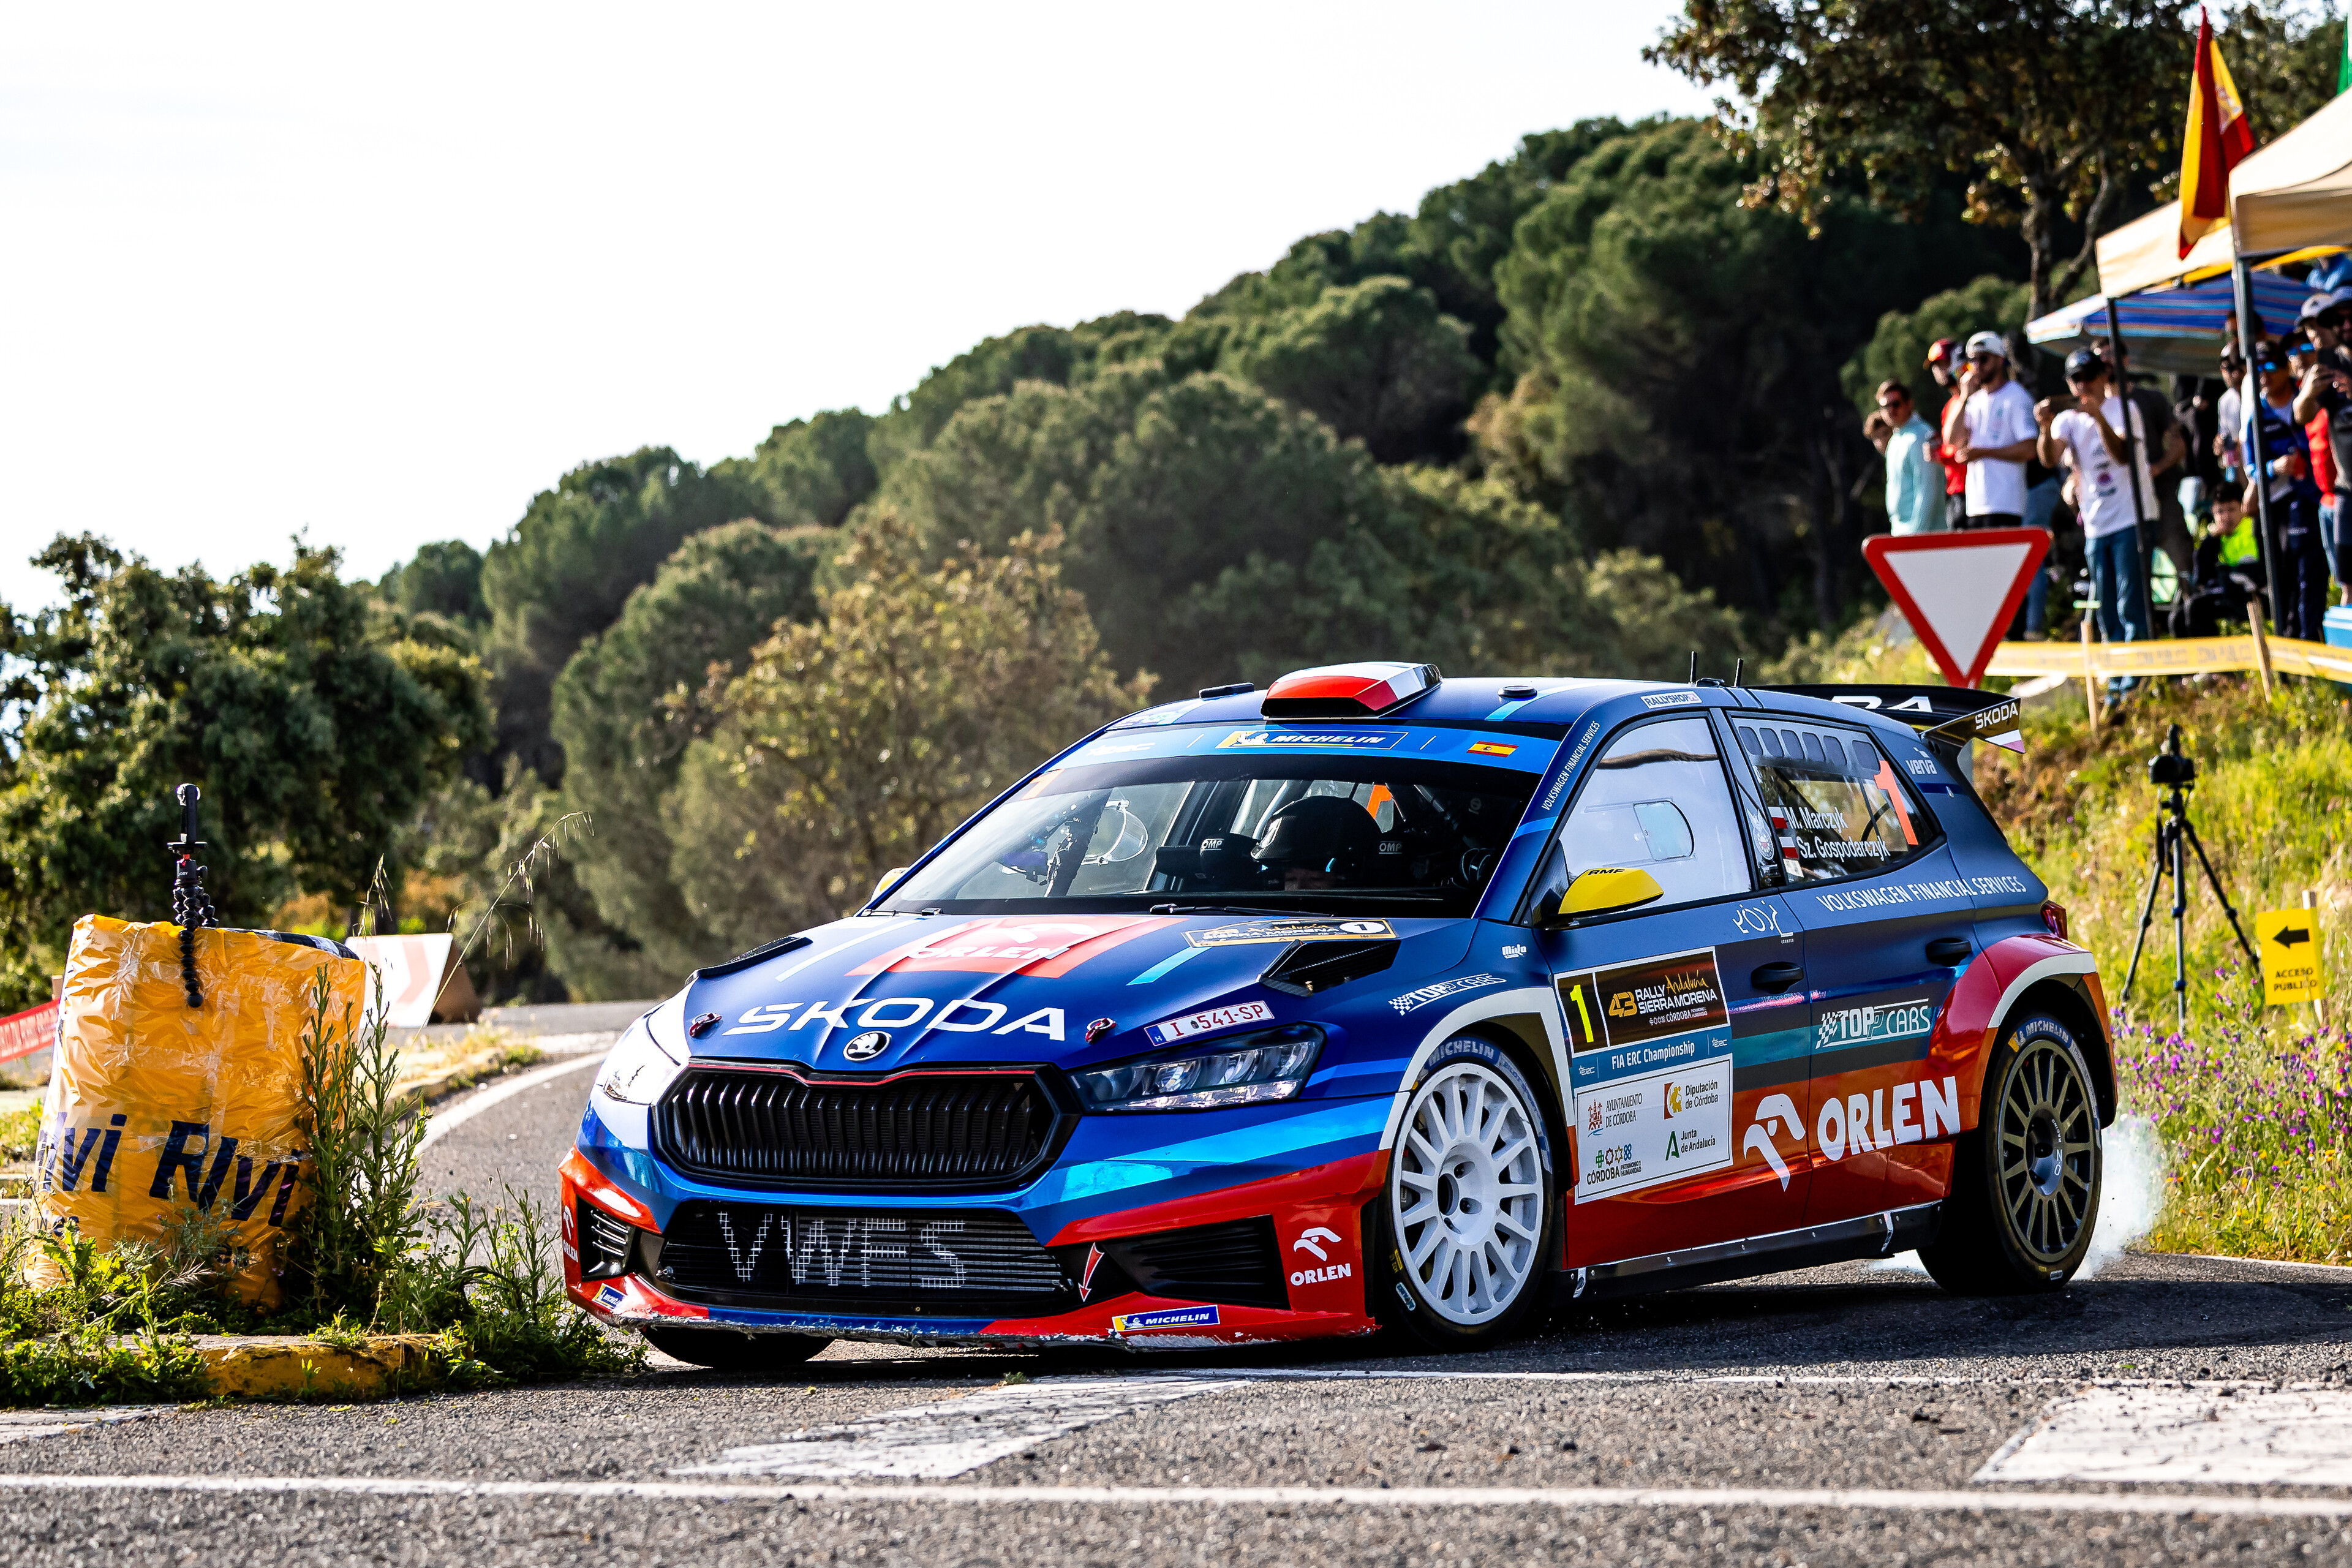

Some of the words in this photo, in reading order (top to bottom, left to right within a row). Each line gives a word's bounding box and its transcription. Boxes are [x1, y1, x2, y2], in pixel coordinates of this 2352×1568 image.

[1643, 694, 1689, 706] RALLYSHOP
[1270, 735, 1387, 745] MICHELIN
[1541, 770, 1570, 810] VOLKSWAGEN
[1564, 743, 1586, 773] FINANCIAL
[1581, 720, 1600, 746] SERVICES
[1905, 759, 1937, 775] verva
[1873, 760, 1919, 845] 1
[1783, 807, 1803, 829] M.
[1799, 807, 1849, 834] Marczyk
[1201, 840, 1223, 850] OMP
[1379, 842, 1402, 852] OMP
[1795, 836, 1816, 858] Sz.
[1814, 835, 1891, 862] Gospodarczyk
[1815, 885, 1910, 912] VOLKSWAGEN
[1907, 879, 1977, 902] FINANCIAL
[1972, 876, 2027, 895] SERVICES
[911, 945, 1069, 960] ORLEN
[1456, 974, 1507, 988] CARS
[2274, 979, 2318, 991] PUBLIO
[1608, 991, 1638, 1017] 43
[1635, 984, 1666, 1001] RALLY
[1665, 970, 1709, 995] Andalucía
[1637, 998, 1675, 1014] SIERRA
[1674, 989, 1717, 1008] MORENA
[1196, 1005, 1264, 1029] 541-SP
[1569, 984, 1594, 1042] 1
[1666, 1009, 1692, 1022] CÓRDOBA
[1886, 1005, 1931, 1035] CARS
[2026, 1020, 2069, 1043] MICHELIN
[1428, 1039, 1494, 1066] MICHELIN
[1611, 1055, 1625, 1069] FIA
[1627, 1050, 1642, 1066] ERC
[1643, 1040, 1695, 1062] Championship
[1685, 1080, 1718, 1096] Diputación
[1605, 1093, 1643, 1112] AYUNTAMIENTO
[1685, 1099, 1693, 1109] de
[1694, 1093, 1719, 1107] Córdoba
[1605, 1115, 1612, 1128] DE
[1611, 1110, 1637, 1127] CÓRDOBA
[1817, 1076, 1961, 1161] ORLEN
[1681, 1129, 1697, 1141] Junta
[2051, 1118, 2062, 1143] RACING
[1681, 1144, 1689, 1153] de
[1689, 1136, 1716, 1152] Andalucía
[1587, 1166, 1620, 1185] CÓRDOBA
[1621, 1166, 1642, 1177] HUMANIDAD
[563, 1239, 579, 1263] ORLEN
[1291, 1263, 1352, 1286] ORLEN
[1145, 1313, 1210, 1325] MICHELIN
